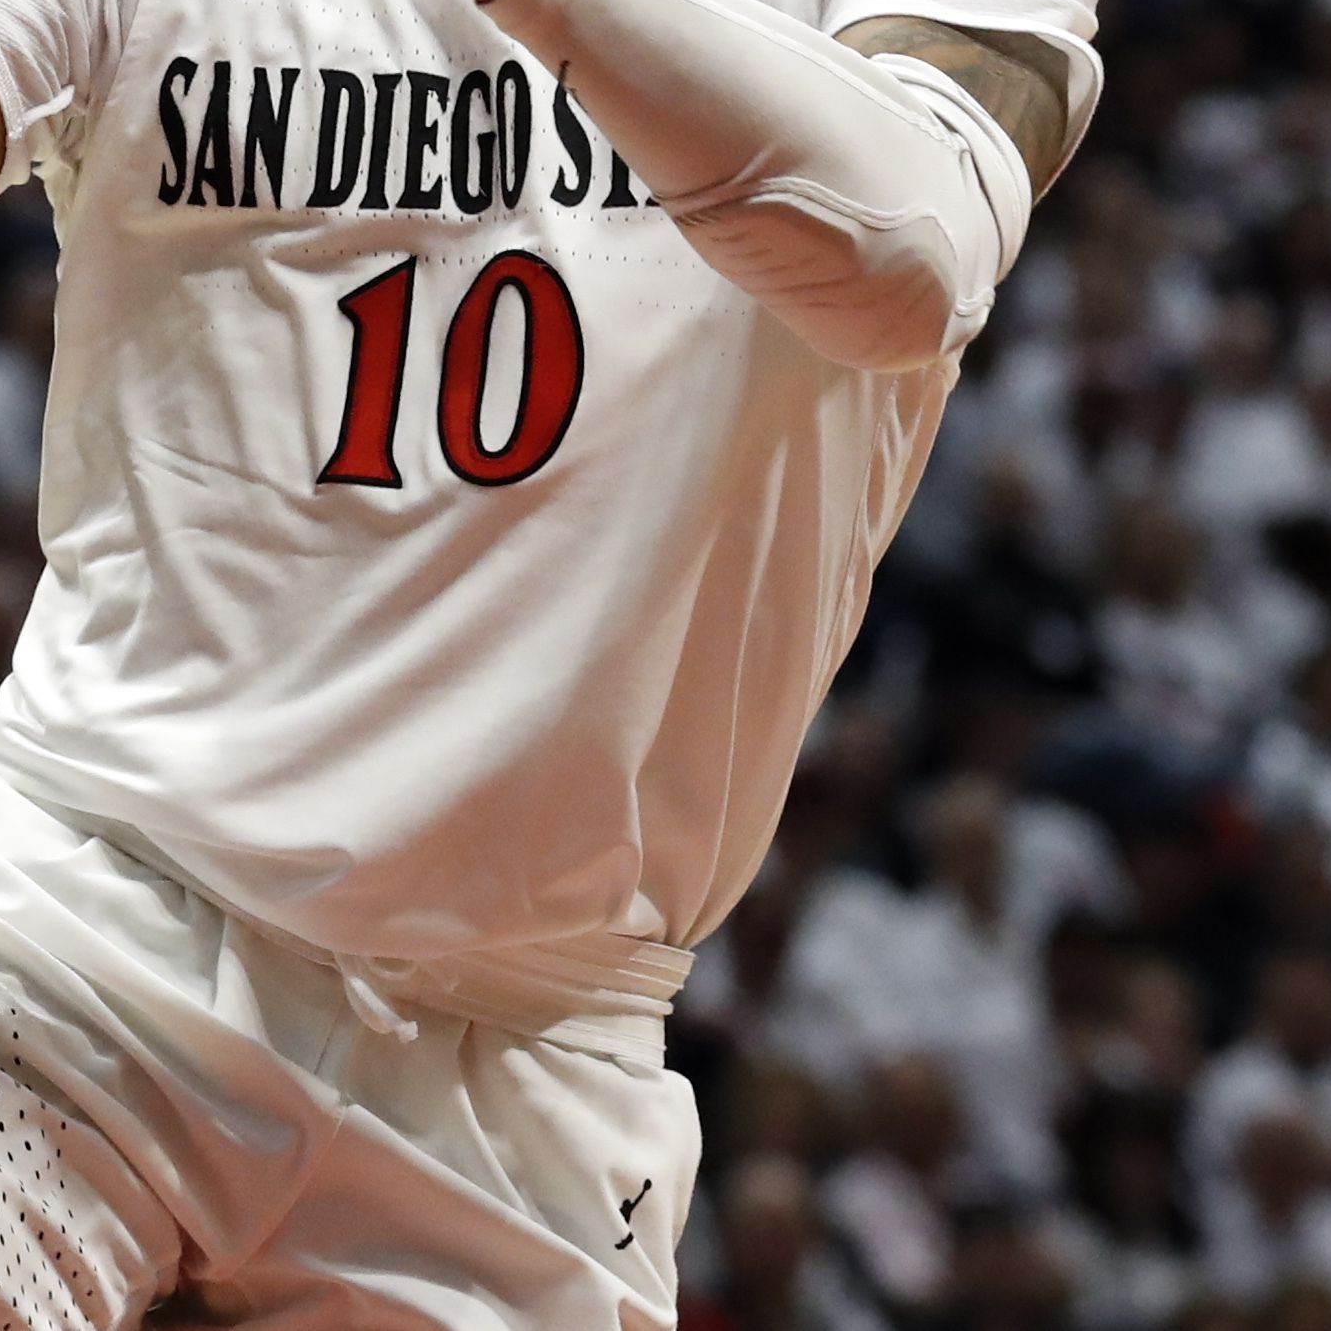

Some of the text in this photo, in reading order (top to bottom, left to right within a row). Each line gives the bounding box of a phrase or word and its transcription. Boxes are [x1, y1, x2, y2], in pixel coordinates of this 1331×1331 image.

[157, 56, 300, 209] SAN
[306, 60, 532, 214] DIEGO
[315, 249, 585, 490] 10
